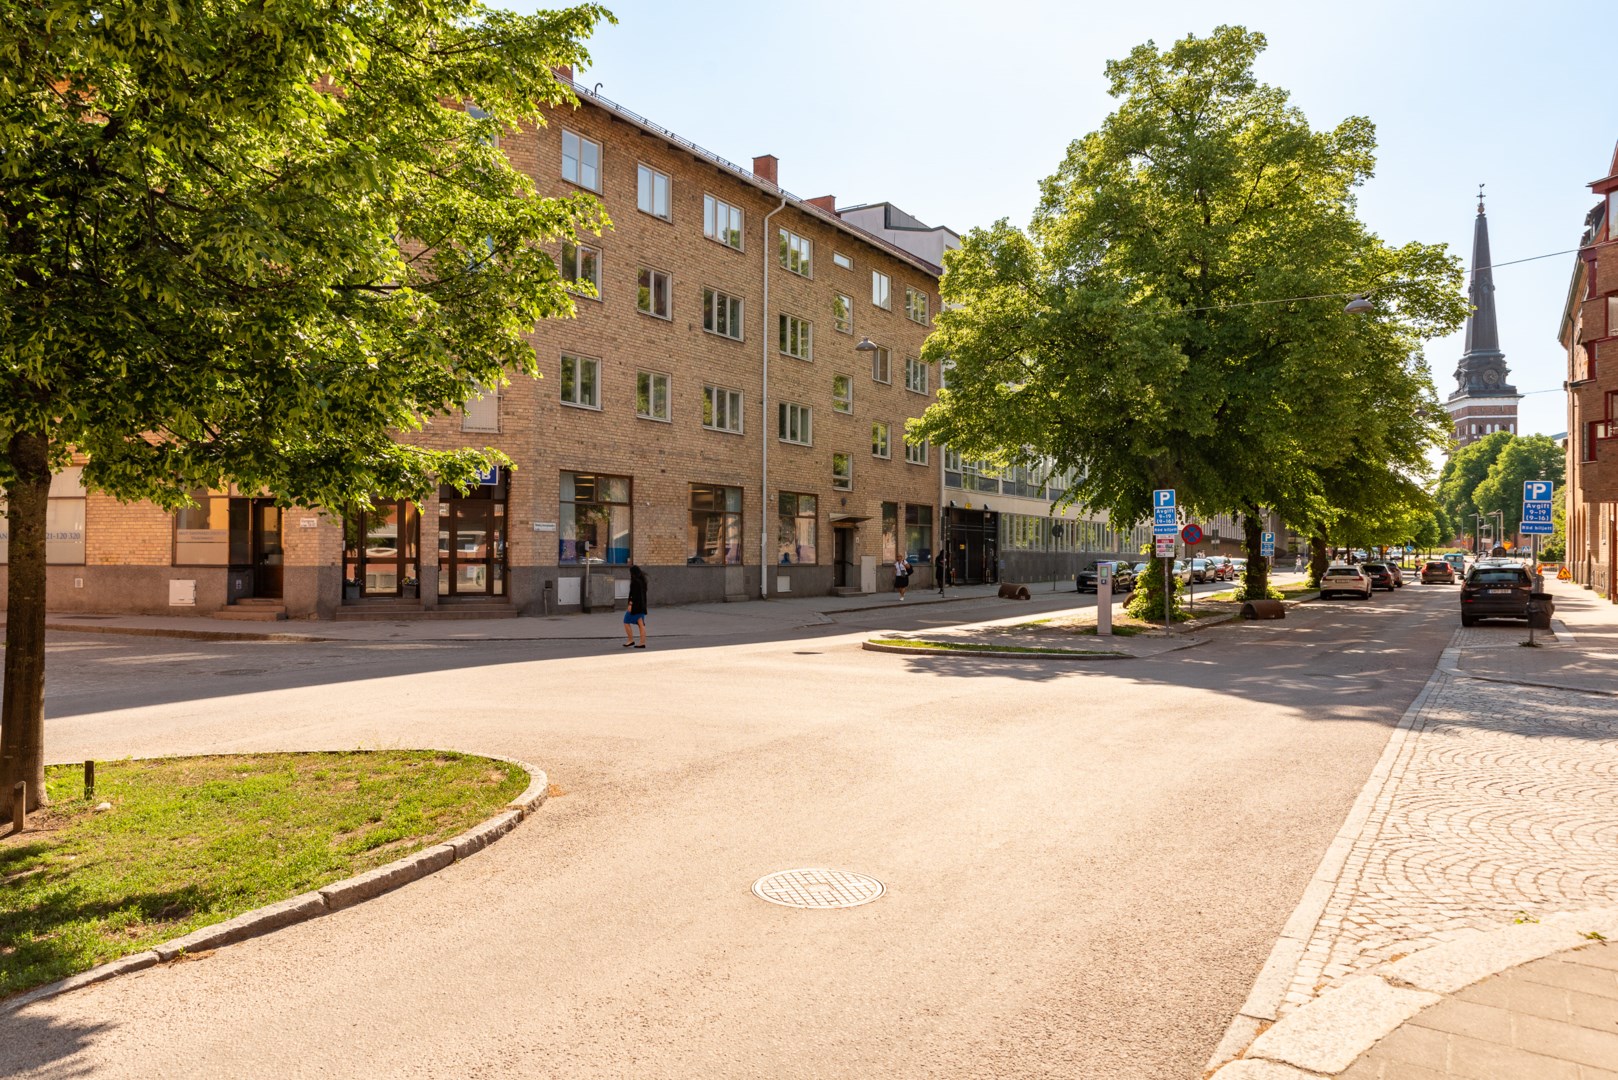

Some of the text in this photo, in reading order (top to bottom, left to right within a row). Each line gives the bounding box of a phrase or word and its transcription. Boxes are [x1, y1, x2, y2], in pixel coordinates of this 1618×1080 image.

[1532, 483, 1547, 499] P
[1160, 492, 1170, 506] P
[46, 532, 81, 540] 21-120 320
